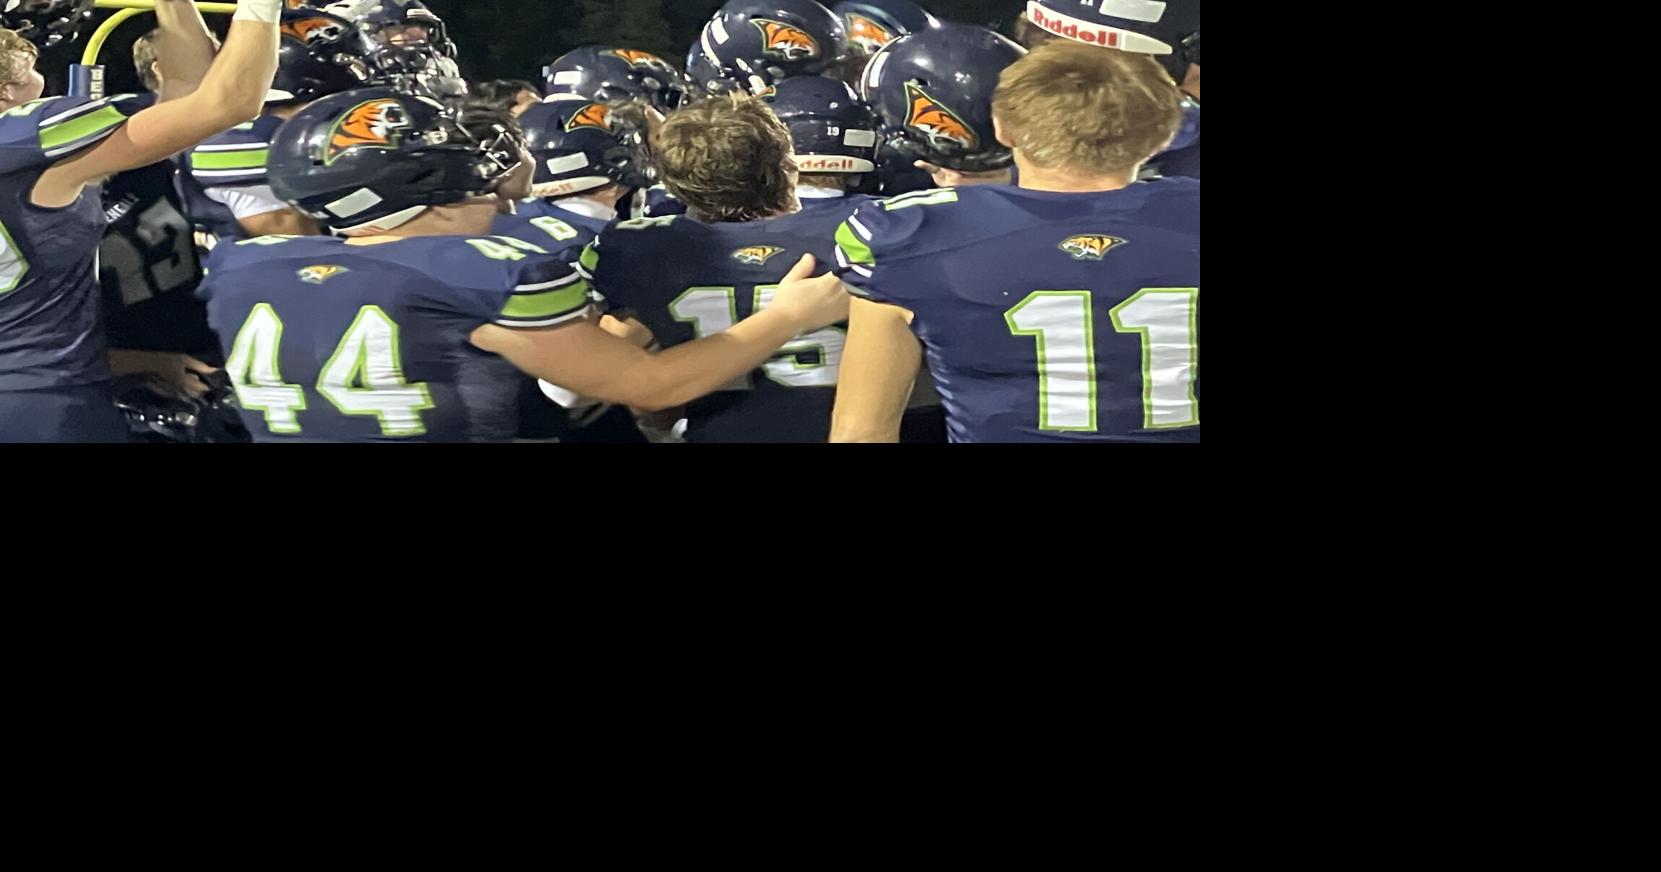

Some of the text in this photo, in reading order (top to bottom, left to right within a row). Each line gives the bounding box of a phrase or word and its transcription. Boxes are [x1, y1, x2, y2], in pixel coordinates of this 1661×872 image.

[1033, 7, 1118, 47] Riddell
[799, 159, 853, 170] ddell
[225, 302, 436, 437] 44
[1003, 287, 1200, 432] 11
